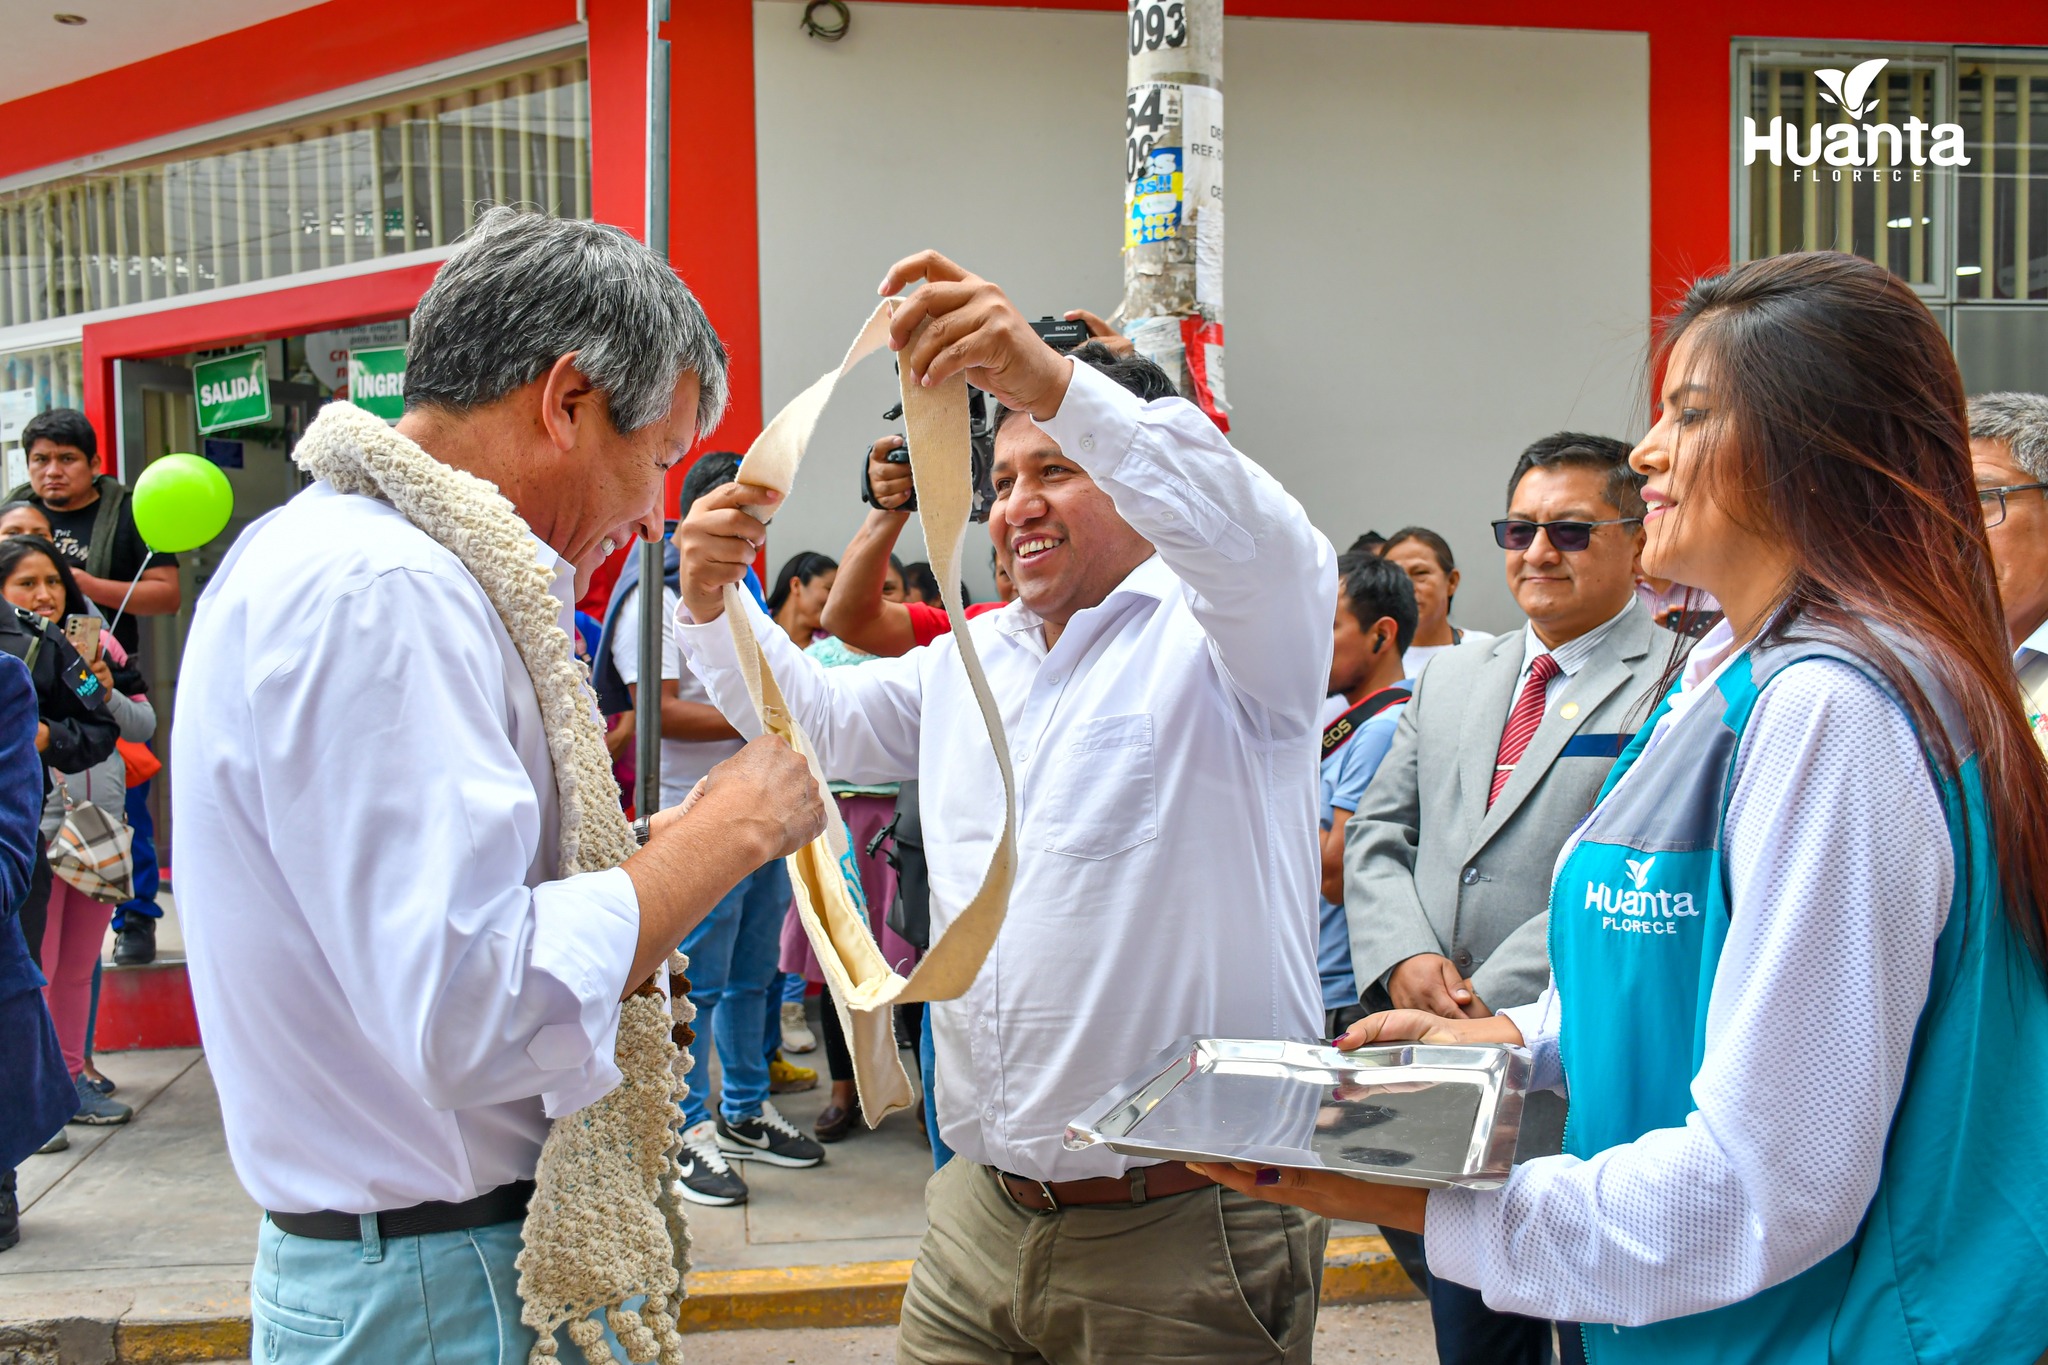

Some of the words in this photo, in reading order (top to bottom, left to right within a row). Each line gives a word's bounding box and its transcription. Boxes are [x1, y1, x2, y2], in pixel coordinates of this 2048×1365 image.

[1131, 3, 1186, 56] 093
[201, 374, 262, 407] SALIDA
[1322, 718, 1353, 749] EOS
[1584, 880, 1700, 919] Huanta
[1602, 916, 1677, 935] FLORECE
